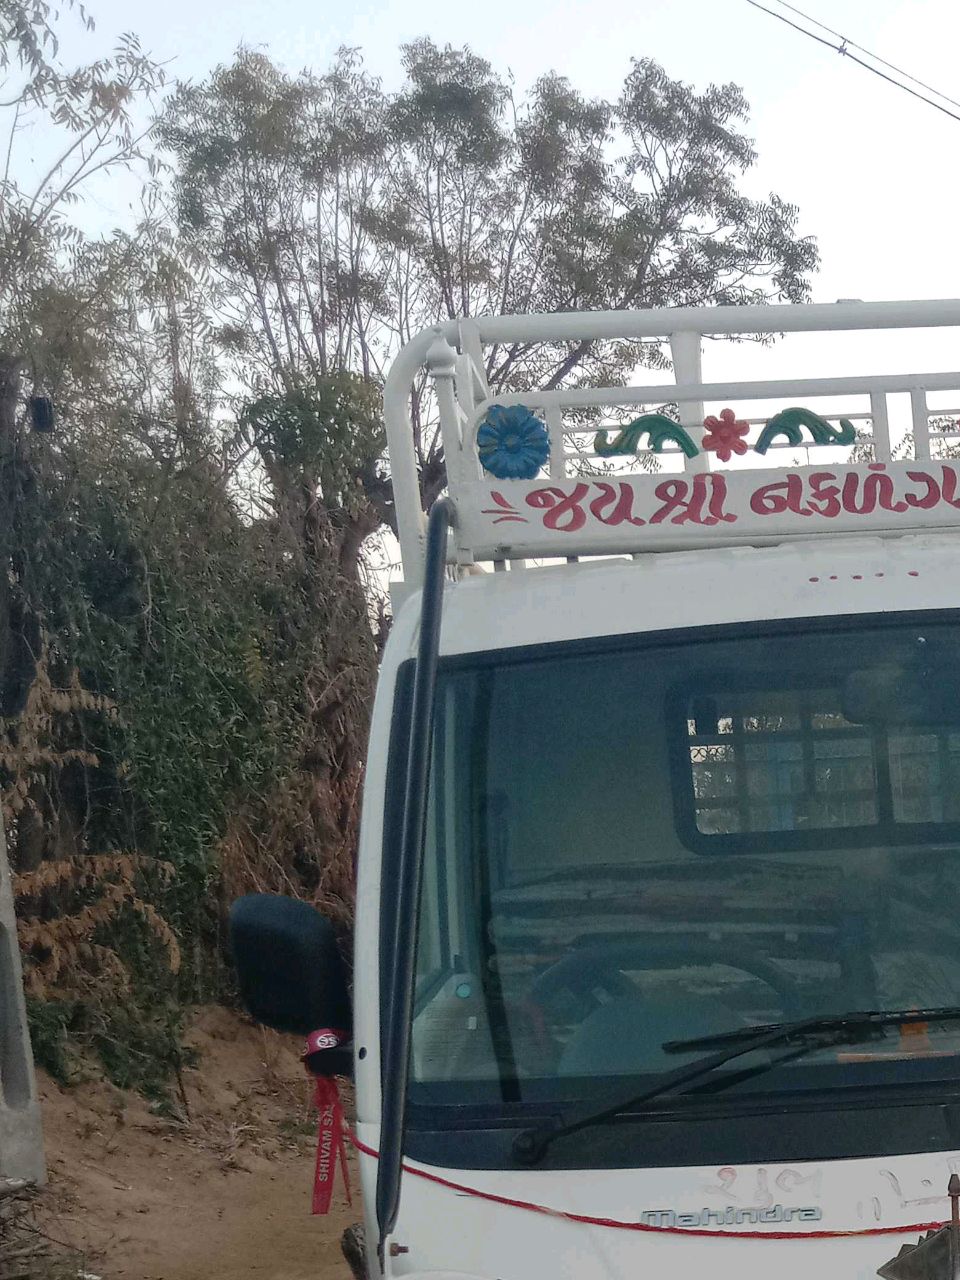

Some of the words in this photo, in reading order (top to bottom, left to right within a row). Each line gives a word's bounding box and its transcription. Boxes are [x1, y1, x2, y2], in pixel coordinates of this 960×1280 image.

[525, 481, 646, 532] જય
[649, 473, 738, 525] શ્રી
[319, 1129, 332, 1182] SHIVAM
[641, 1203, 823, 1228] Mahindra
